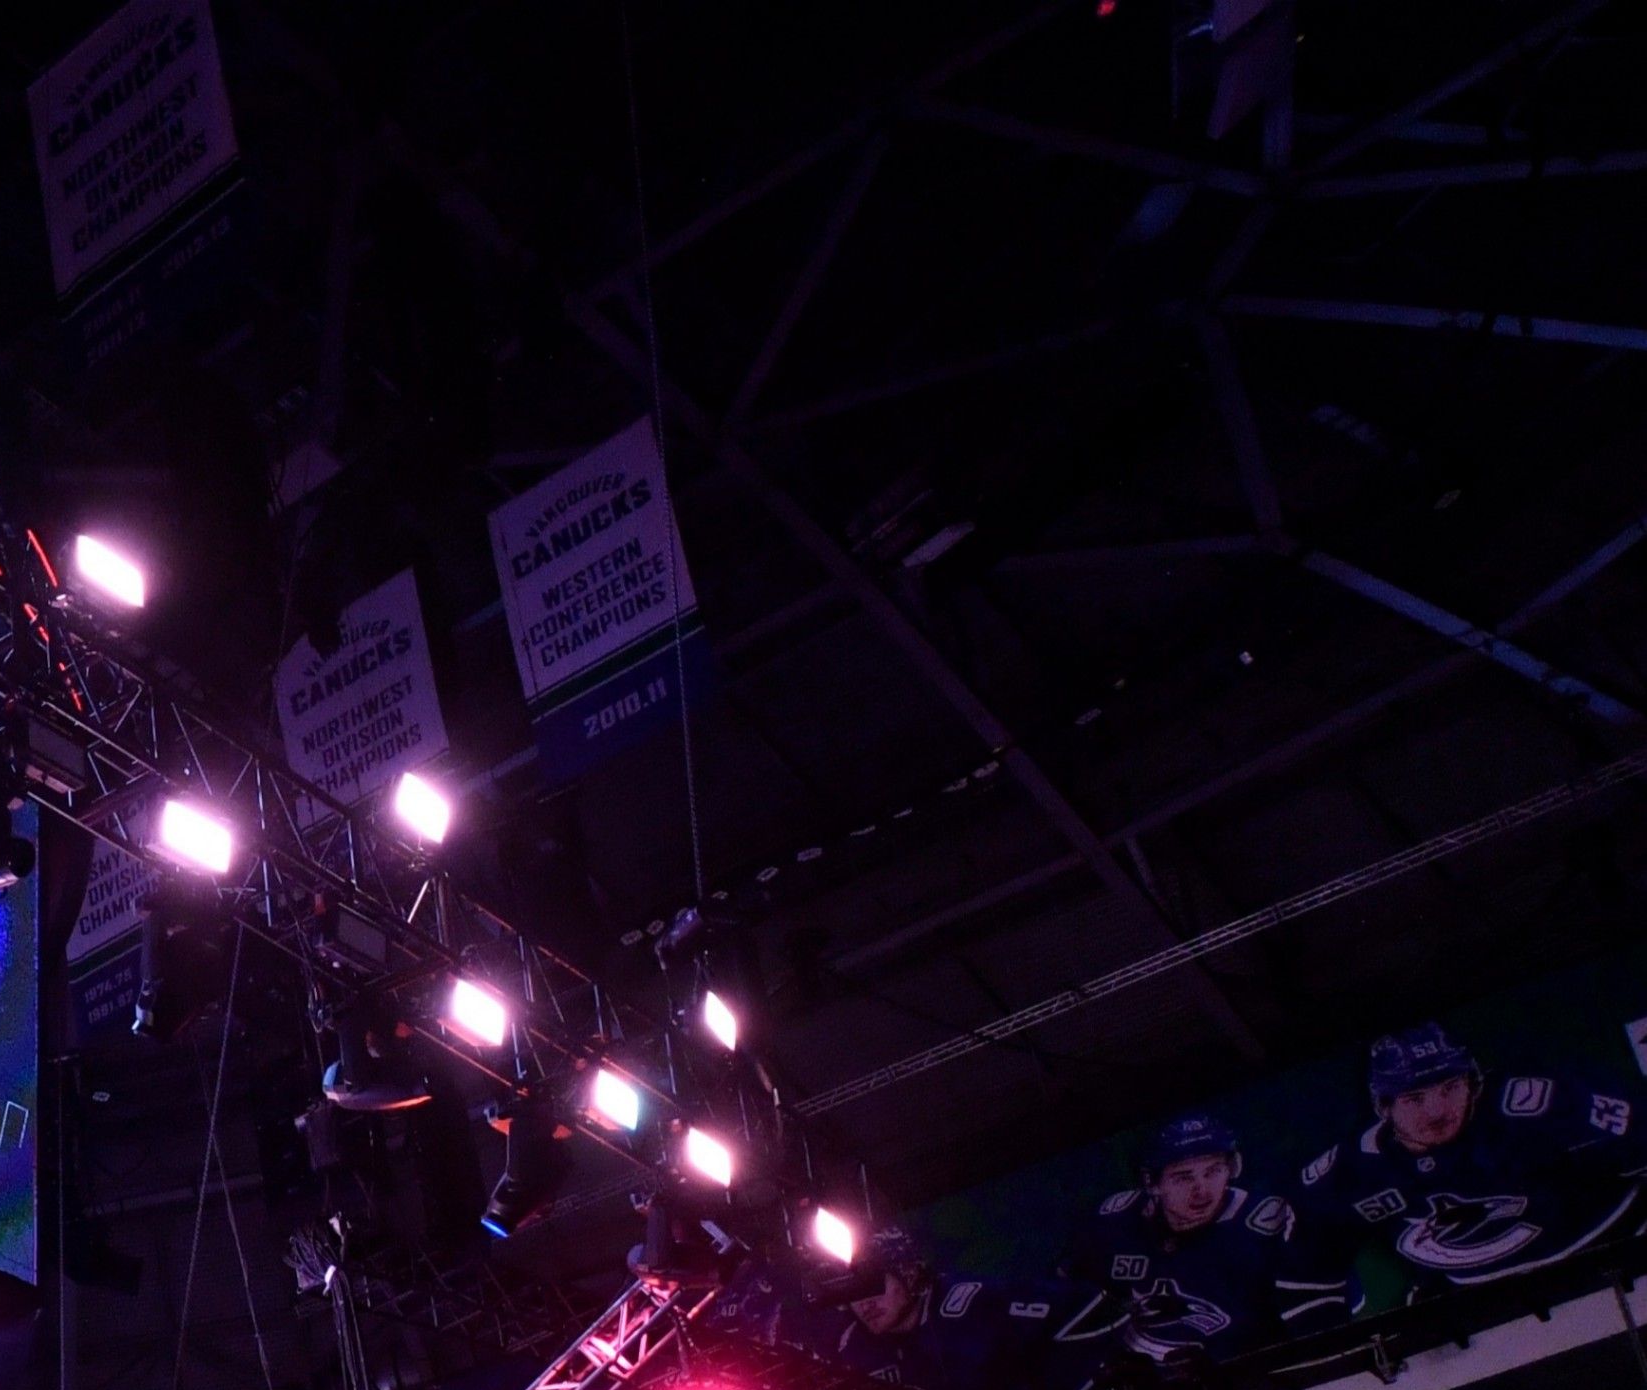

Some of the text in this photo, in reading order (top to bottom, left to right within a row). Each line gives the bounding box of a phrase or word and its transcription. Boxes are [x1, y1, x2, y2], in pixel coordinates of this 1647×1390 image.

[51, 18, 196, 154] CANUCKS
[73, 128, 206, 252] CHAMPIONS
[511, 479, 652, 580] CANUCKS
[525, 473, 625, 539] VANCOUVER
[529, 552, 667, 647] CONFERENCE
[542, 537, 643, 610] WESTERN
[540, 581, 667, 668] CHAMPIONS
[290, 628, 411, 717] CANUCKS
[582, 677, 669, 740] 2010.11
[303, 675, 412, 754] NORTHWEST
[323, 708, 403, 769] DIVISION
[315, 723, 423, 793] CHAMPIONS
[1113, 1256, 1146, 1279] 50
